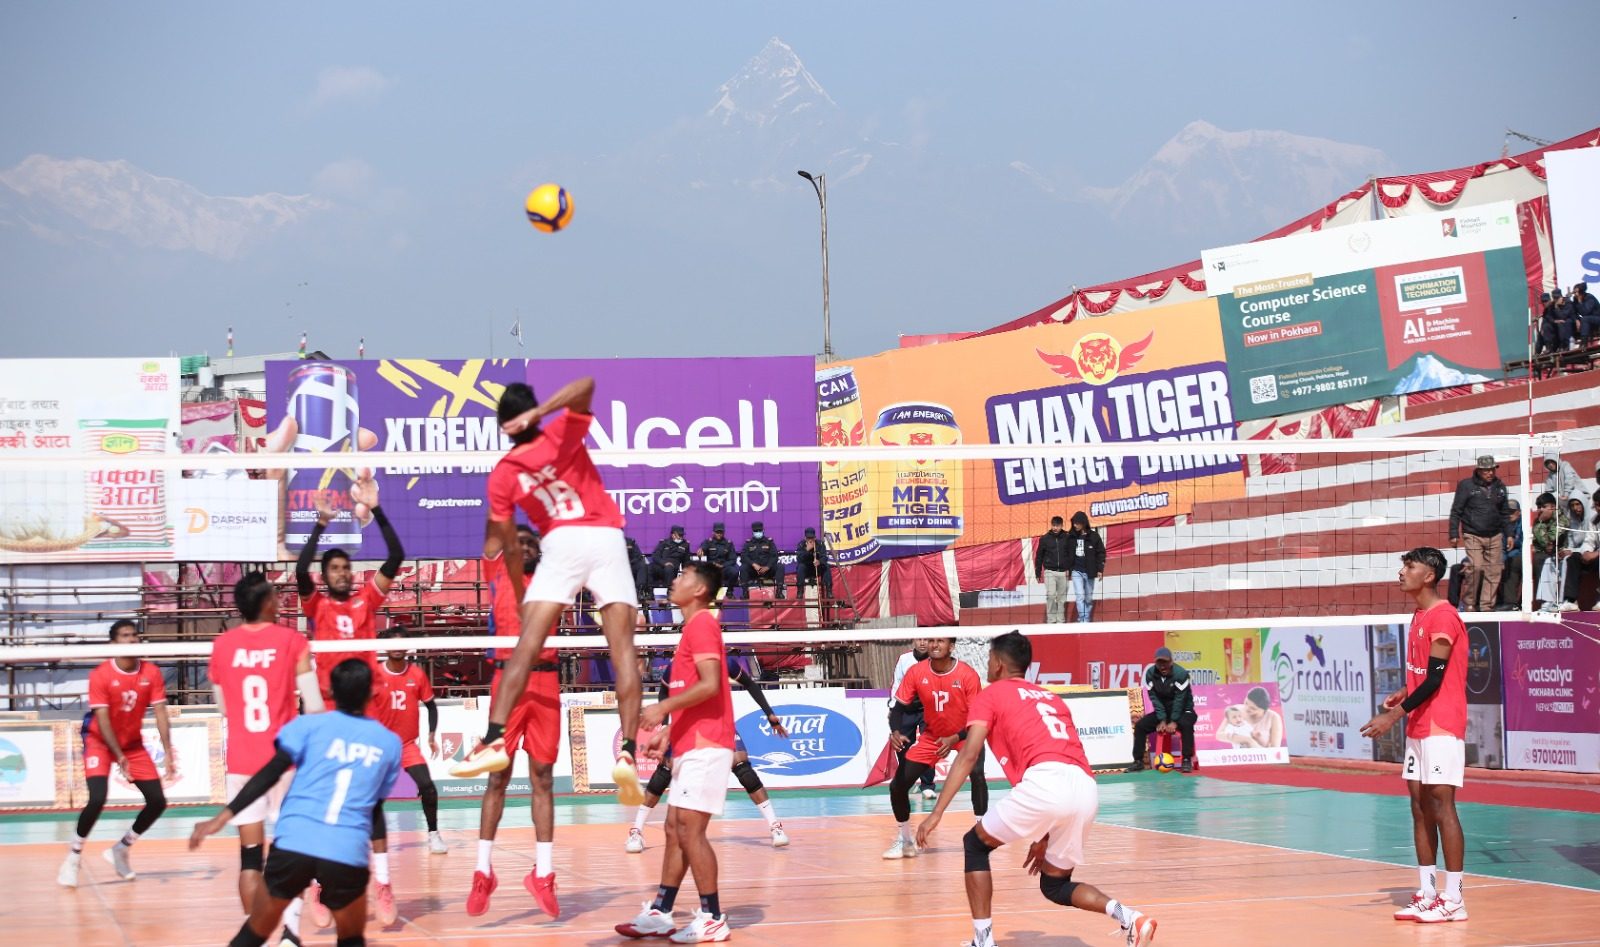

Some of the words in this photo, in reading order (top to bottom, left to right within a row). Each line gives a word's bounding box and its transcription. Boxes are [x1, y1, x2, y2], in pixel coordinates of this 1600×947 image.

[1237, 287, 1254, 295] The
[1404, 279, 1457, 292] INFORMATION
[1406, 286, 1457, 298] TECHNOLOGY
[1240, 293, 1310, 313] Computer
[1312, 283, 1367, 301] Science
[1242, 311, 1291, 328] Course
[1403, 317, 1426, 339] AI
[1432, 318, 1460, 327] Machine
[1427, 324, 1456, 332] Learning
[1247, 333, 1268, 344] Now
[1270, 330, 1279, 339] in
[1281, 324, 1318, 338] Pokhara
[1292, 382, 1336, 396] +977-9802
[1337, 376, 1368, 389] 851717
[897, 411, 911, 420] AM
[994, 390, 1102, 445] MAX
[1107, 370, 1233, 440] TIGER
[34, 436, 71, 448] आटा
[583, 400, 779, 467] Ncell
[1003, 455, 1125, 497] ENERGY
[1138, 427, 1240, 476] DRINK
[101, 486, 160, 505] आटा
[418, 498, 482, 509] #goxtreme
[893, 485, 949, 503] MAX
[824, 502, 862, 520] 330
[892, 503, 950, 515] TIGER
[1090, 492, 1169, 517] #mymaxtiger
[211, 515, 268, 524] DARSHAN
[889, 518, 925, 526] ENERGY
[927, 518, 953, 526] DRINK
[232, 648, 277, 668] APF
[1297, 659, 1364, 692] Franklin
[1527, 665, 1574, 687] vatsalya
[390, 690, 407, 710] 12
[1529, 688, 1555, 697] POKHARA
[1555, 688, 1574, 697] CLINIC
[242, 674, 271, 733] 8
[1036, 702, 1070, 740] 6
[1305, 709, 1350, 728] AUSTRALIA
[325, 738, 384, 768] APF
[789, 738, 826, 756] दूध
[1407, 755, 1415, 774] 2
[1532, 748, 1577, 766] 9701021111
[325, 768, 353, 825] 1
[443, 785, 473, 793] Mustang
